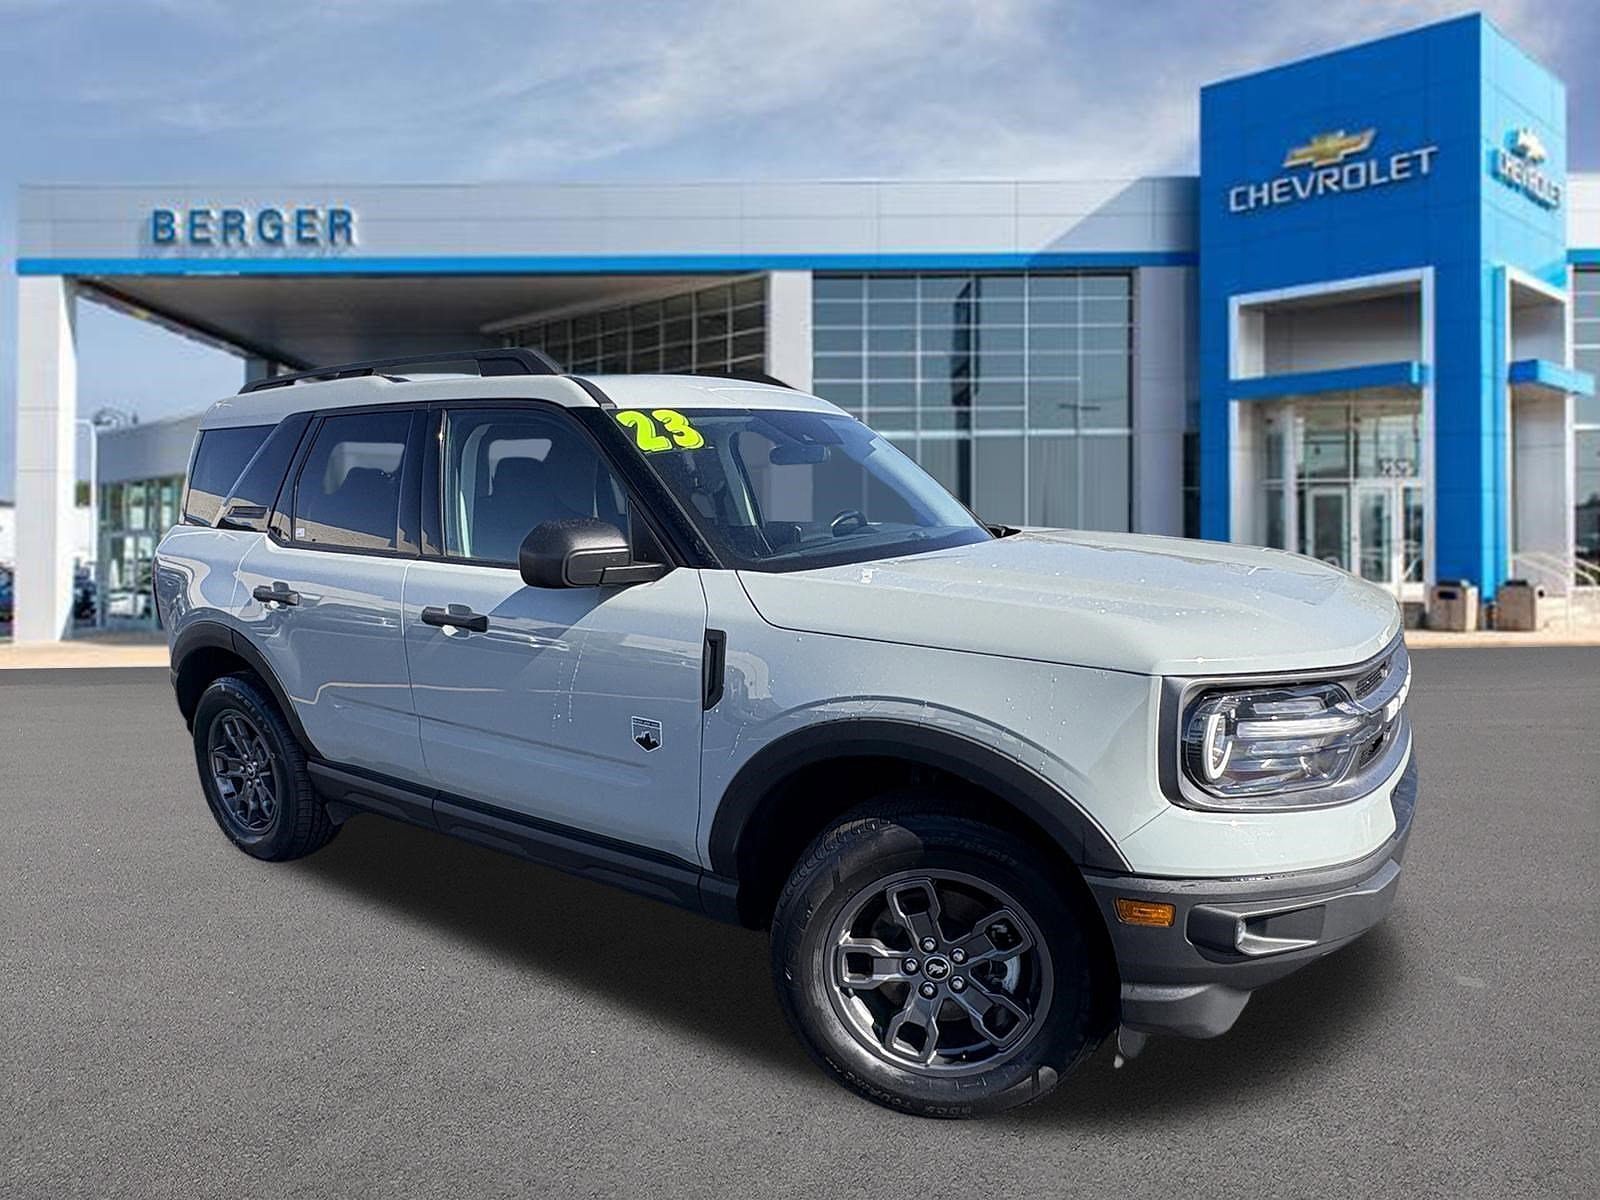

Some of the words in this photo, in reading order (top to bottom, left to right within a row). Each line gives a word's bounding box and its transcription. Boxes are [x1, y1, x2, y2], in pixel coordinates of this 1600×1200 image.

[1229, 146, 1438, 212] CHEVROLET
[152, 208, 355, 248] BERGER
[615, 408, 705, 453] 23
